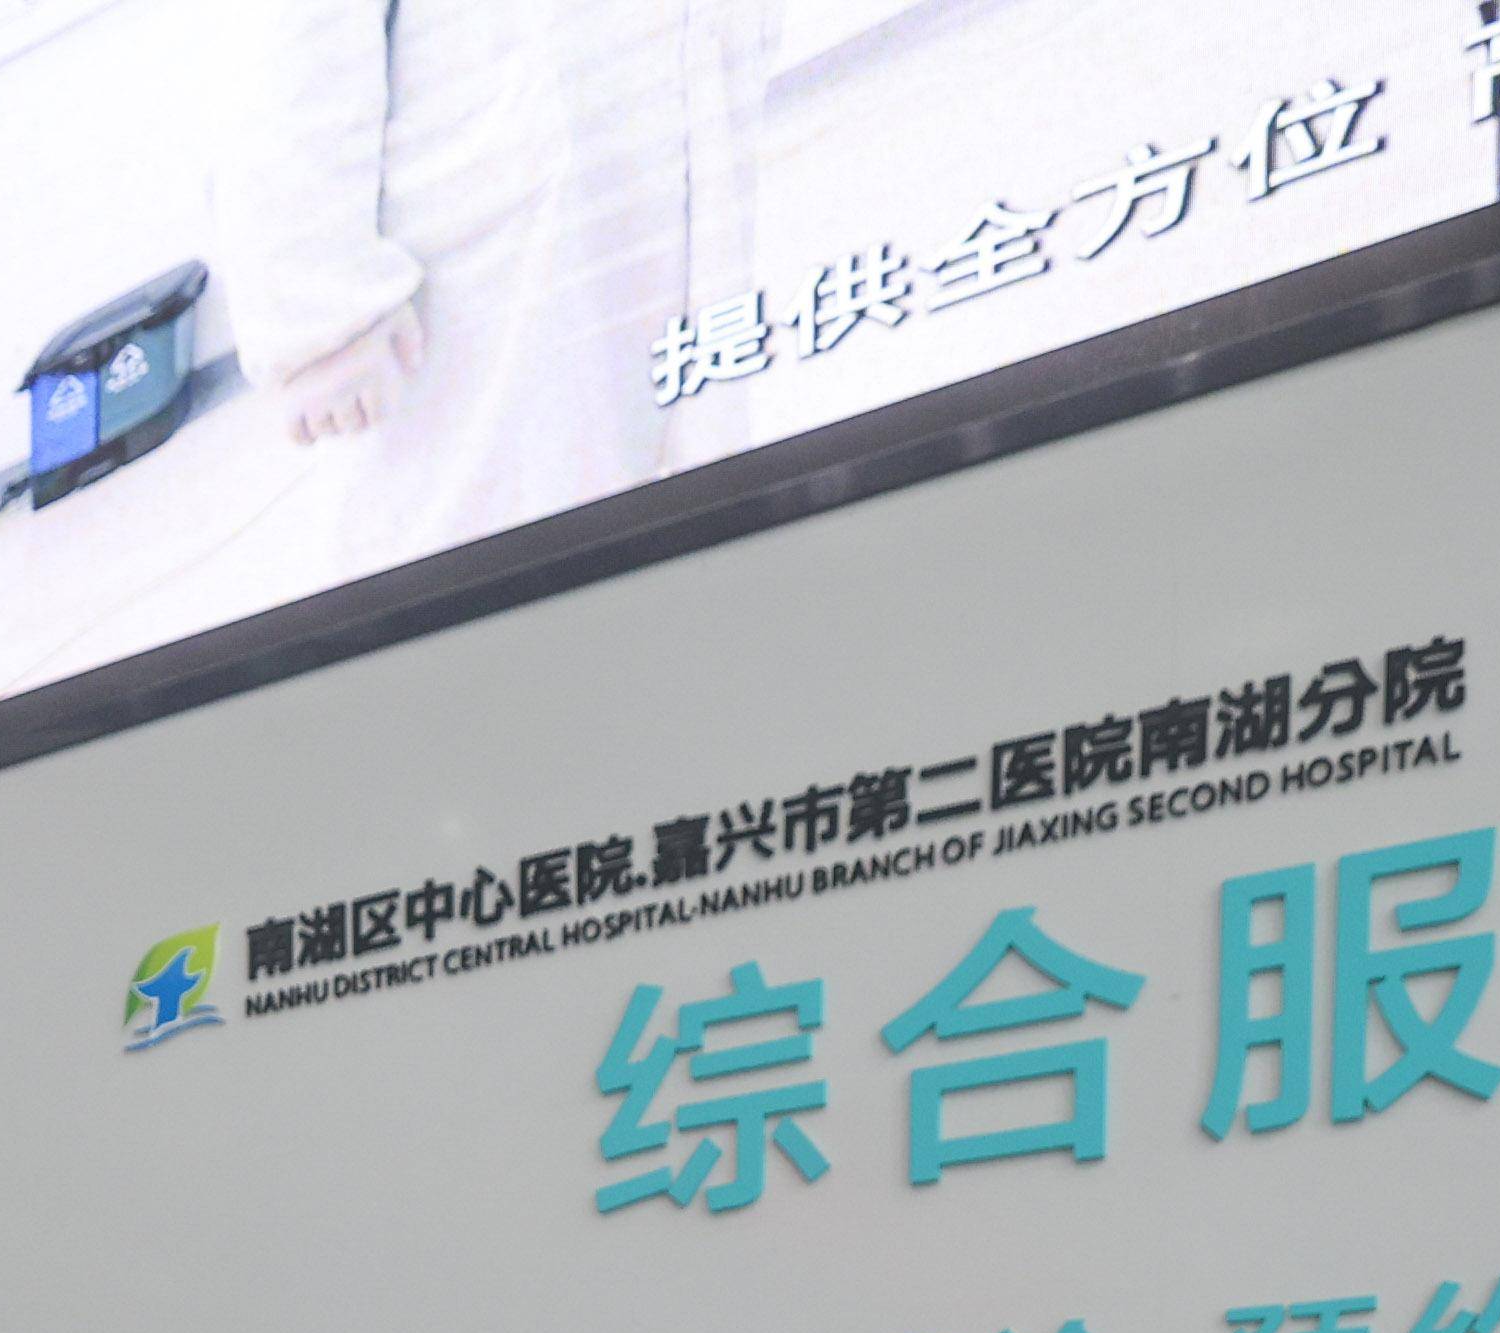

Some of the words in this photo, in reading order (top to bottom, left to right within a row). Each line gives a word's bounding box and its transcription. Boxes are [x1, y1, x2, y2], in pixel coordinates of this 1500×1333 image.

[648, 78, 1388, 406] 提供全方位
[245, 980, 330, 1018] NANHU
[332, 954, 438, 1000] DISTRICT
[443, 929, 556, 976] CENTRAL
[812, 846, 936, 896] BRANCH
[941, 831, 984, 866] OF
[992, 801, 1119, 857] JIAXING
[1128, 770, 1271, 828] SECOND
[1280, 731, 1462, 795] HOSPITAL
